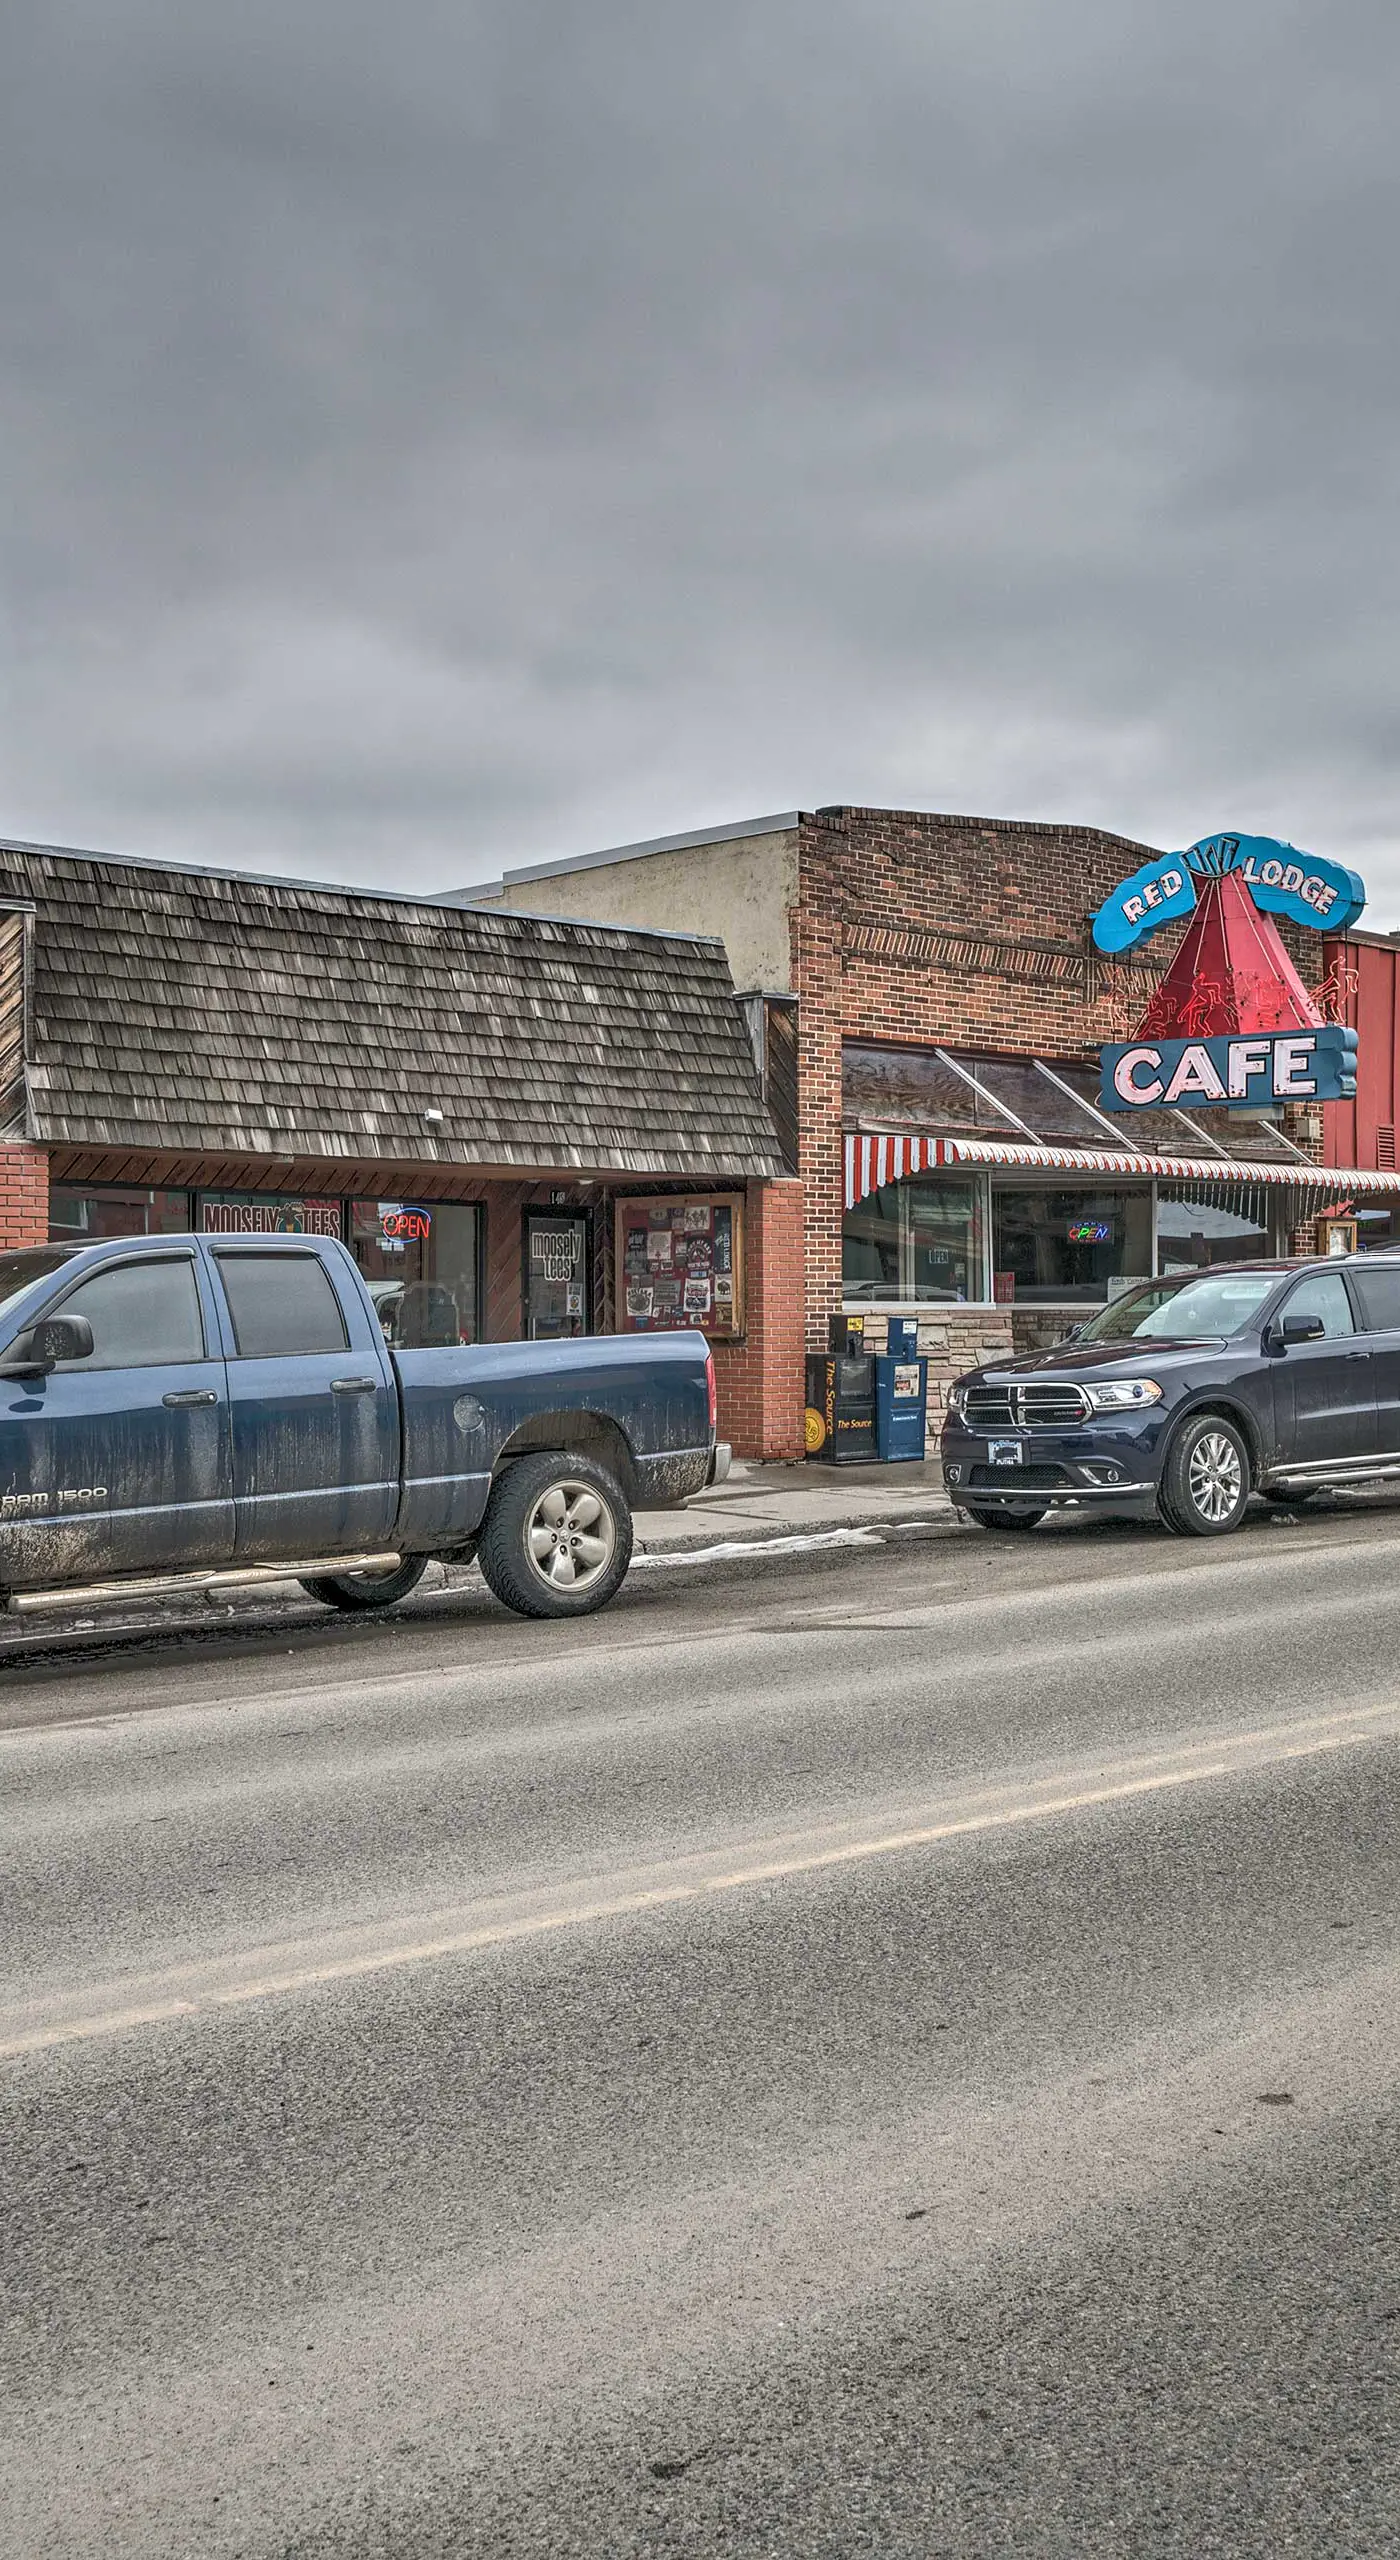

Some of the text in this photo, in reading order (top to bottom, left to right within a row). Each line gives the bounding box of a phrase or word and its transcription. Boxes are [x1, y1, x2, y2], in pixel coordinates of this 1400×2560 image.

[1120, 855, 1340, 927] RED LODGE
[1113, 1036, 1318, 1106] CAFE
[302, 1207, 341, 1240] TEES
[383, 1212, 431, 1239] OPEN
[1069, 1226, 1108, 1241] OPEN
[532, 1229, 581, 1263] moosely
[543, 1256, 572, 1281] tees
[826, 1360, 836, 1435] The Source
[837, 1418, 872, 1429] The Source
[2, 1487, 108, 1505] RAM 1500
